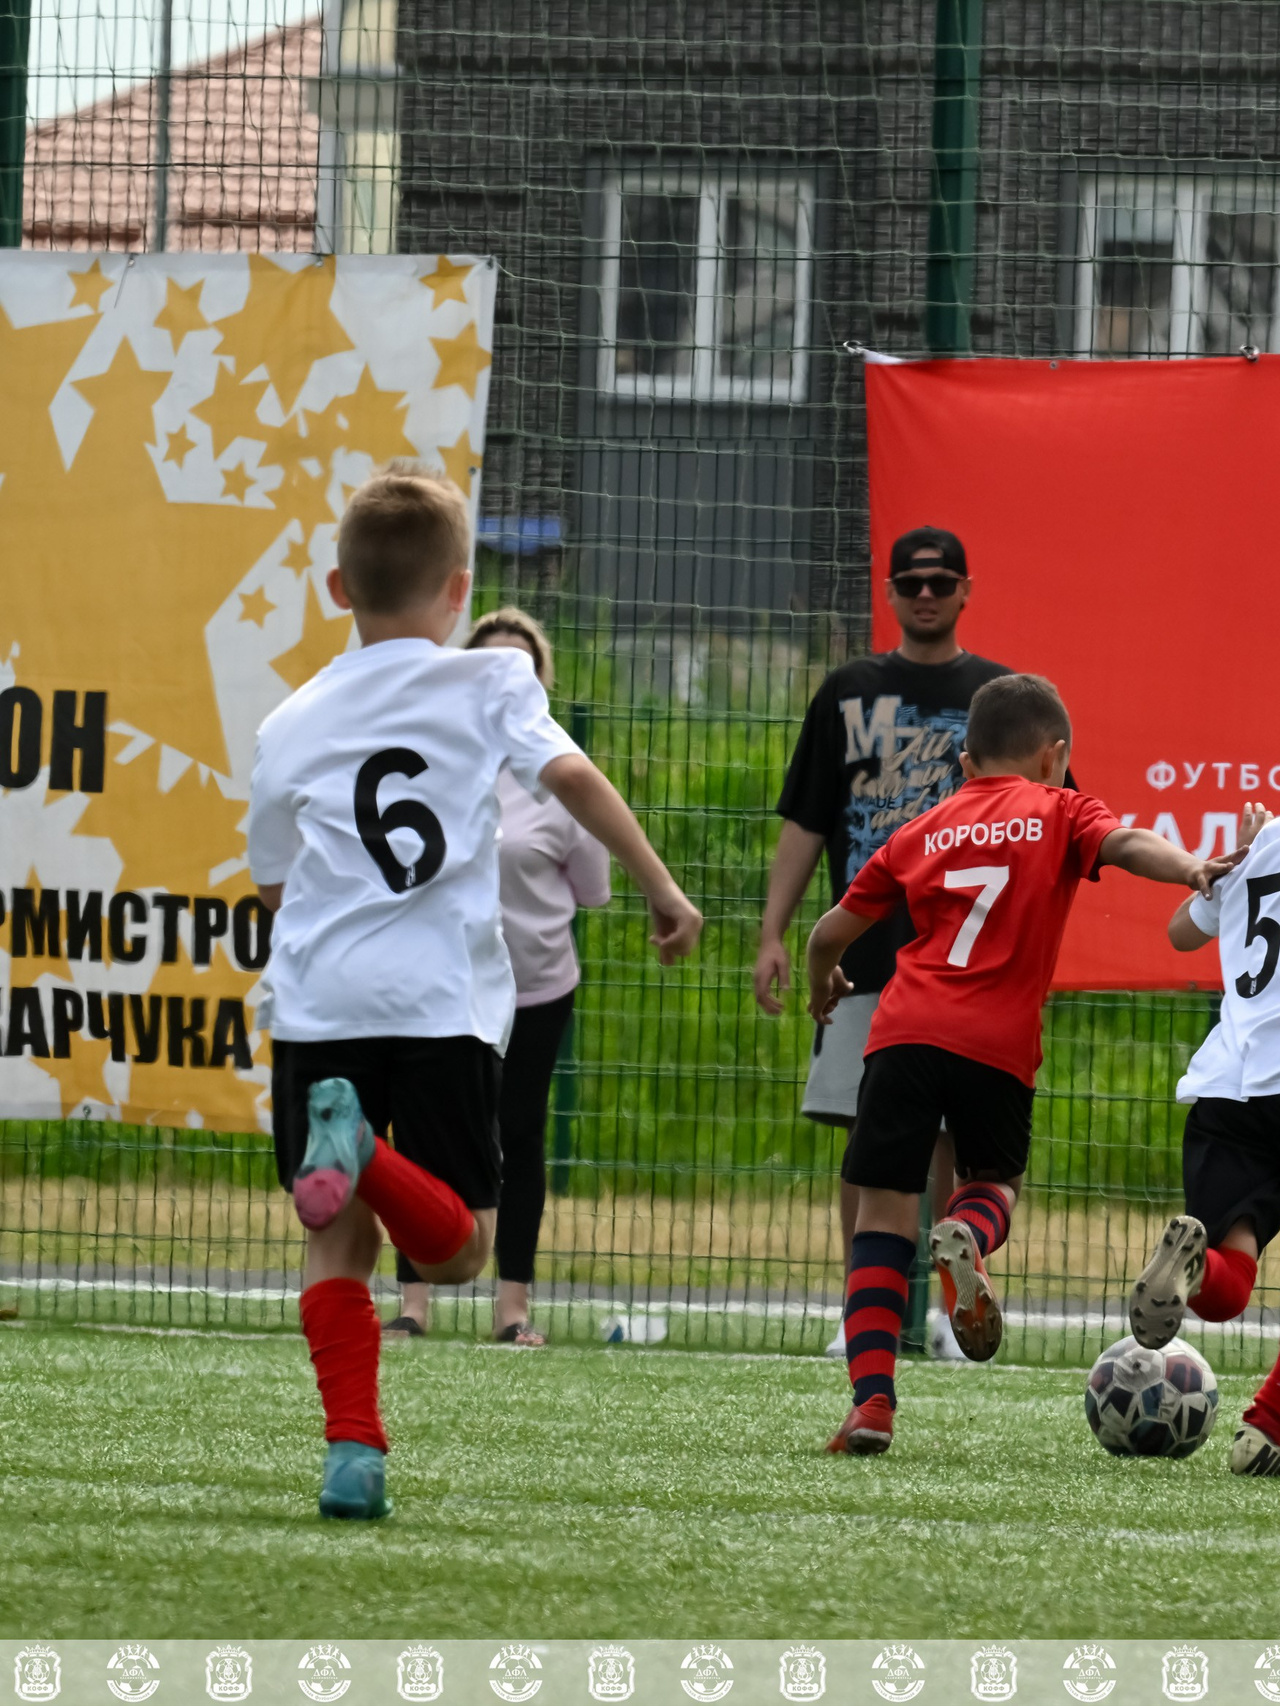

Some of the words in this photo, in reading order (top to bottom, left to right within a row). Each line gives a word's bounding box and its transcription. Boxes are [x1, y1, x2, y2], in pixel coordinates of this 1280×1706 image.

[353, 746, 447, 894] 6
[924, 817, 1043, 857] КОРОБОВ
[0, 887, 275, 972] МИСТРО
[943, 865, 1010, 968] 7
[0, 986, 254, 1069] АРЧУКА
